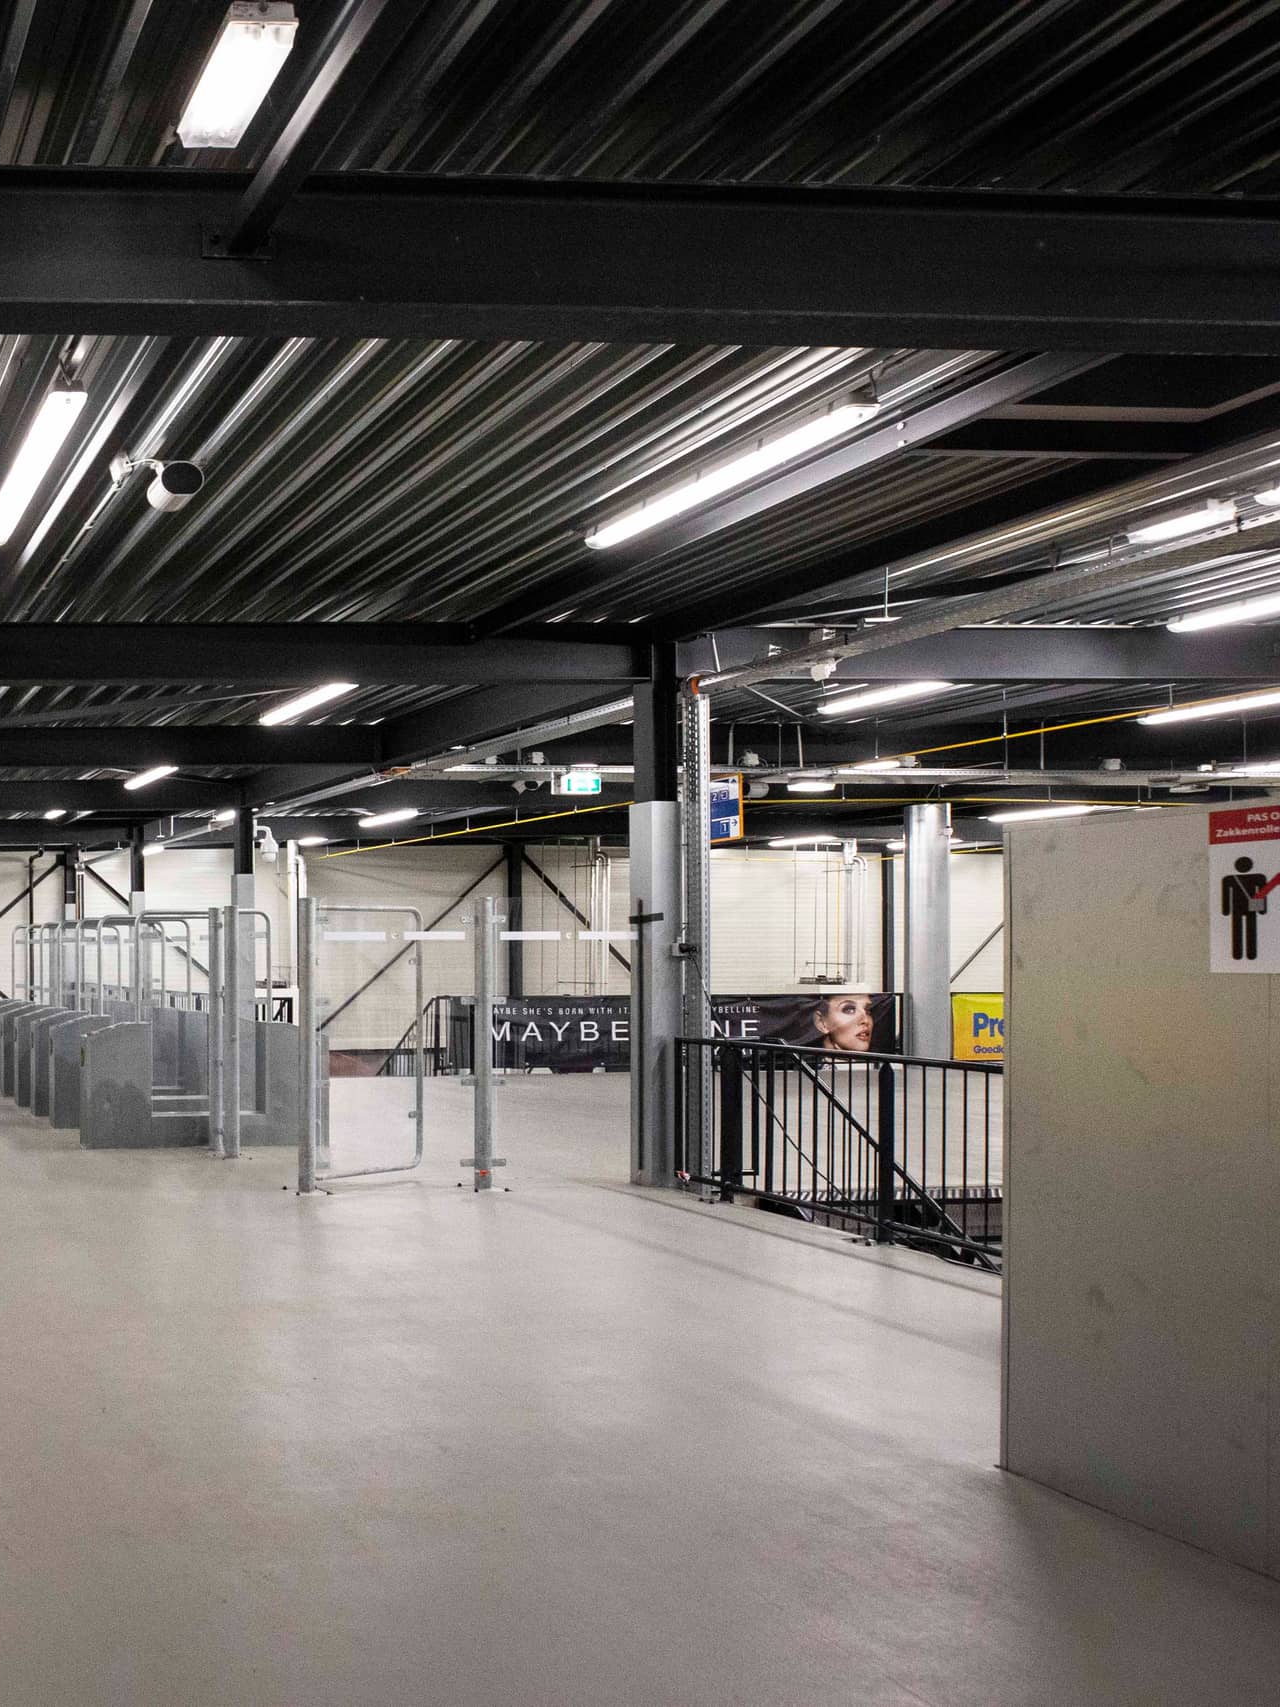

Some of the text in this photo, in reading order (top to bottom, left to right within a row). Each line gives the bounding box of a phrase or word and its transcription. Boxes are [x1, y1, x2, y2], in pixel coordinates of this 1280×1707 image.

[1247, 811, 1280, 822] PAS O
[1215, 825, 1280, 837] Zakkenrolle
[493, 1007, 518, 1015] AYBE
[522, 1007, 553, 1016] SHE'S
[711, 1006, 758, 1014] YBELLINE
